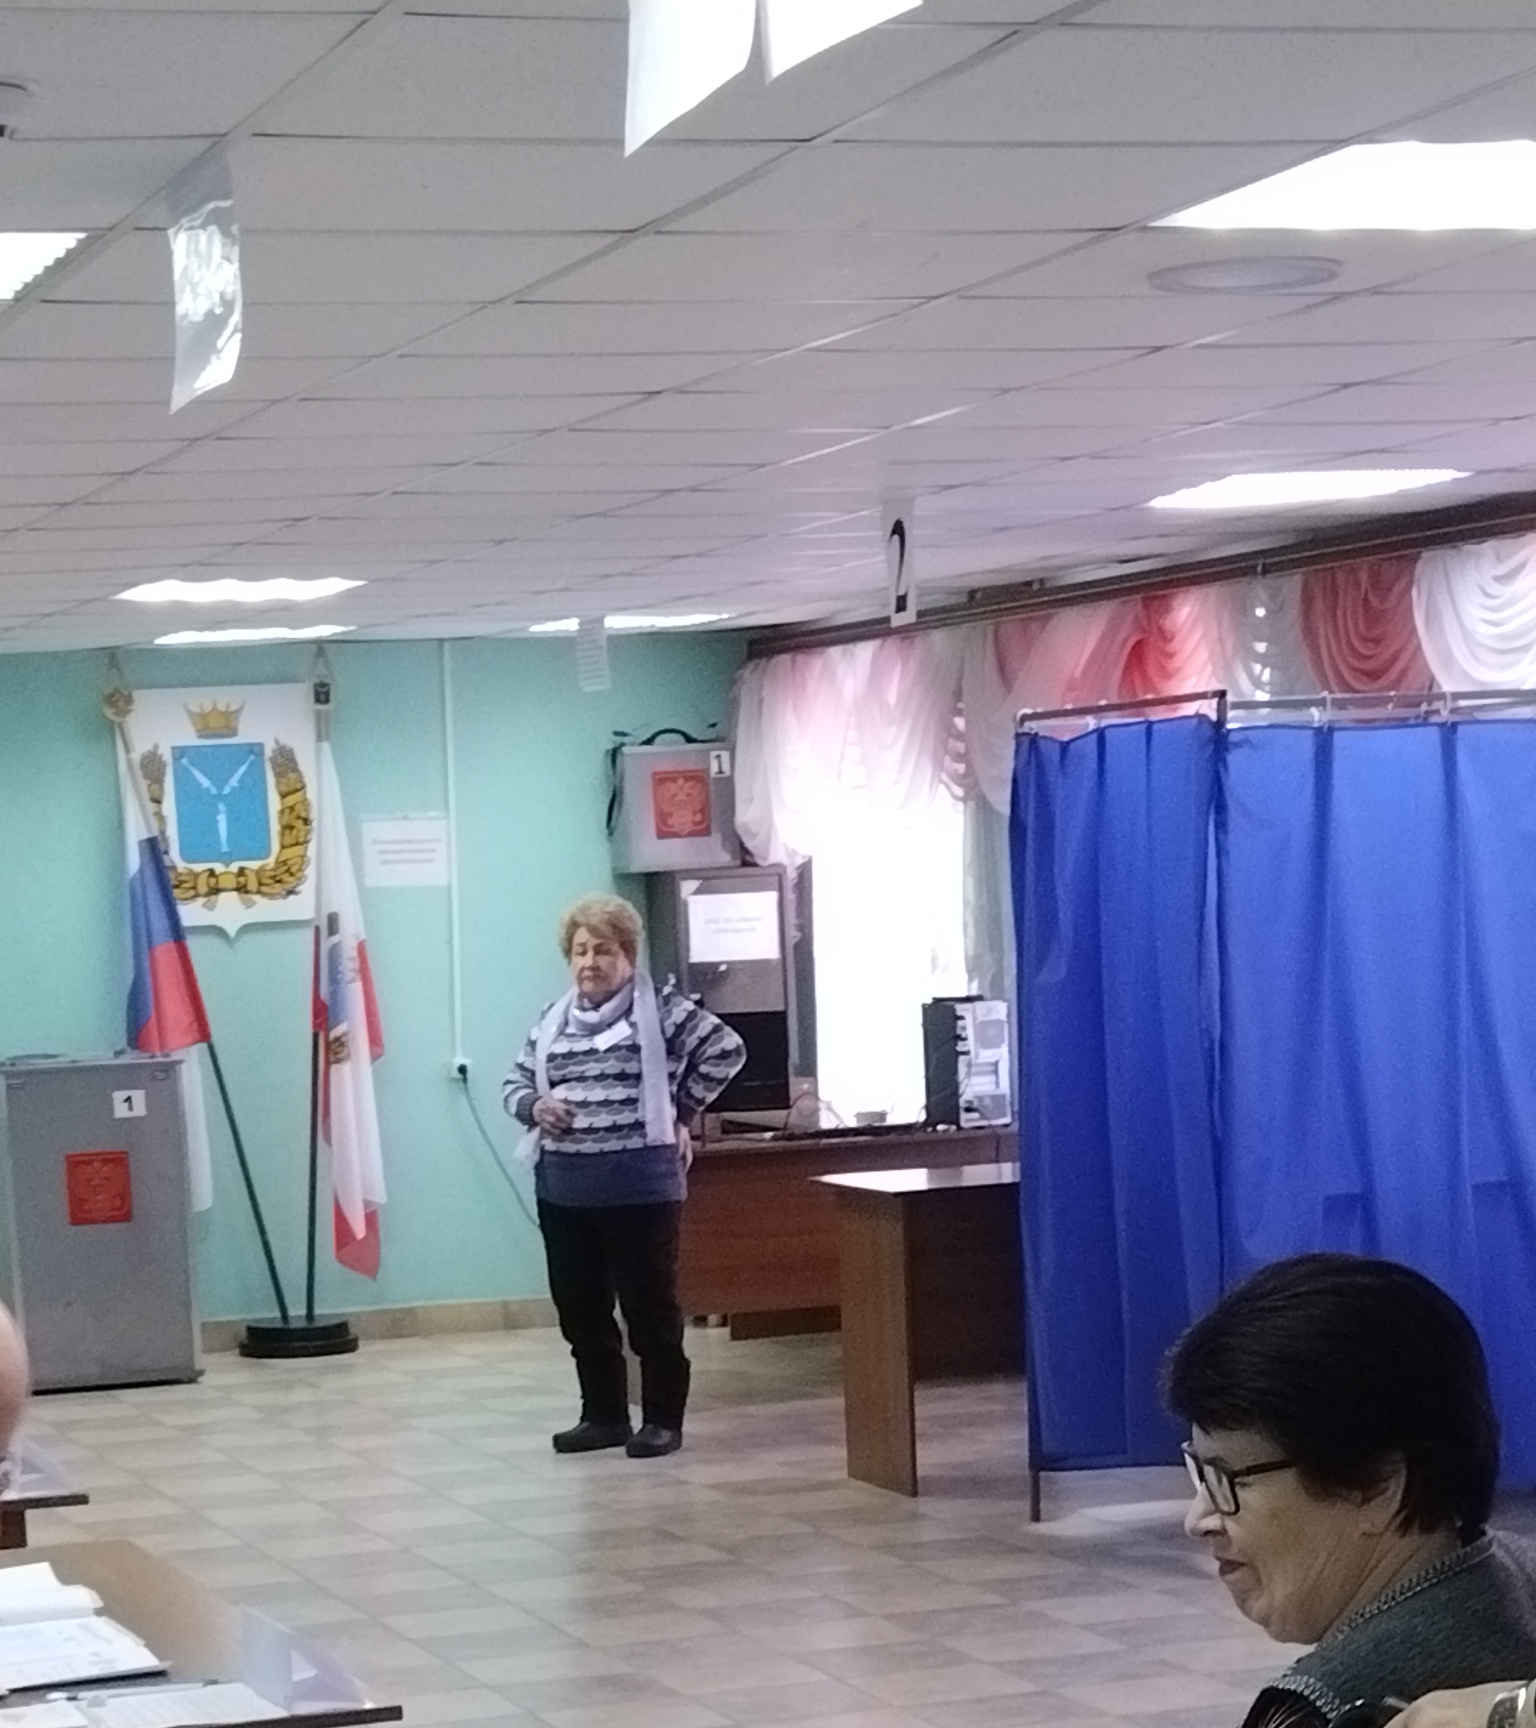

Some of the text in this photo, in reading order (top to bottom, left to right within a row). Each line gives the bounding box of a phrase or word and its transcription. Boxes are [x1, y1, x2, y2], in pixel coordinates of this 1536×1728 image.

[888, 517, 910, 614] 2
[714, 753, 726, 775] 1
[122, 1094, 134, 1113] 1
